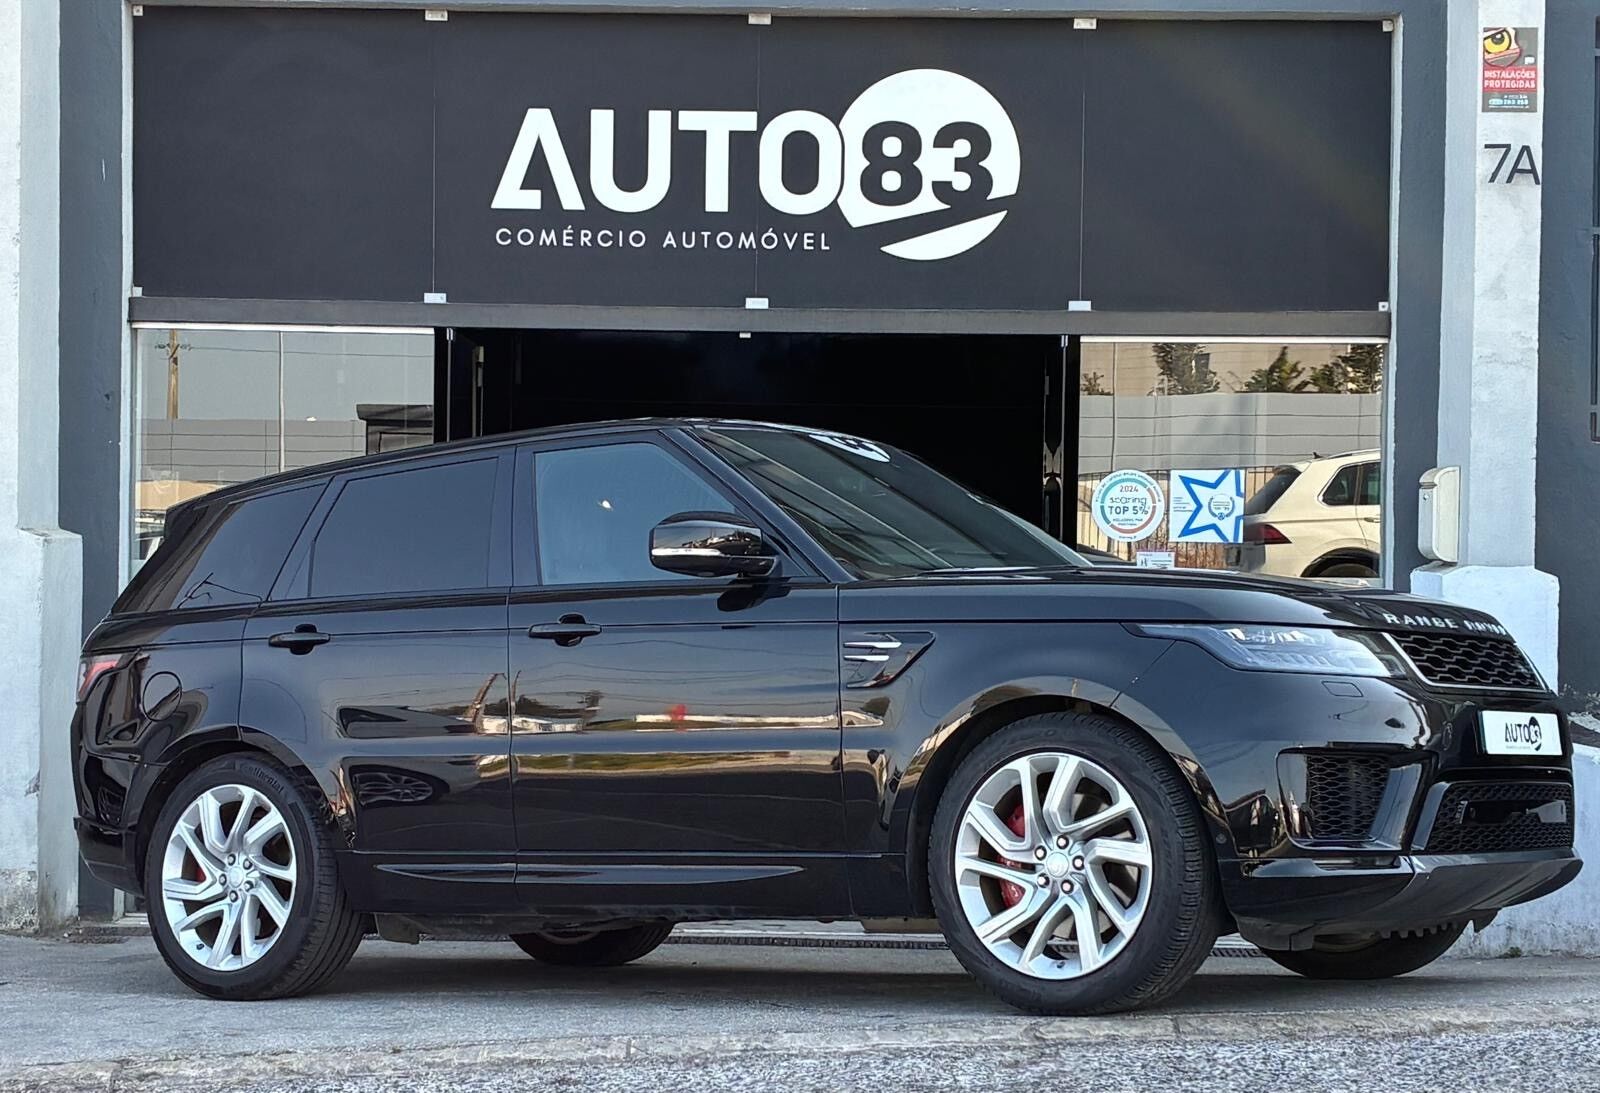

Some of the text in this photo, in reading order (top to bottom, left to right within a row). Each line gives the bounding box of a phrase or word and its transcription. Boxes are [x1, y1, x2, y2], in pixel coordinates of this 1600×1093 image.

[1484, 69, 1536, 80] INSTALAÇÕES
[1484, 79, 1536, 89] PROTEGIDAS
[1484, 143, 1541, 185] 7A
[495, 225, 831, 252] COMÉRCIO AUTOMÓVEL
[1119, 485, 1139, 493] 2024
[1108, 505, 1149, 515] TOP 5%
